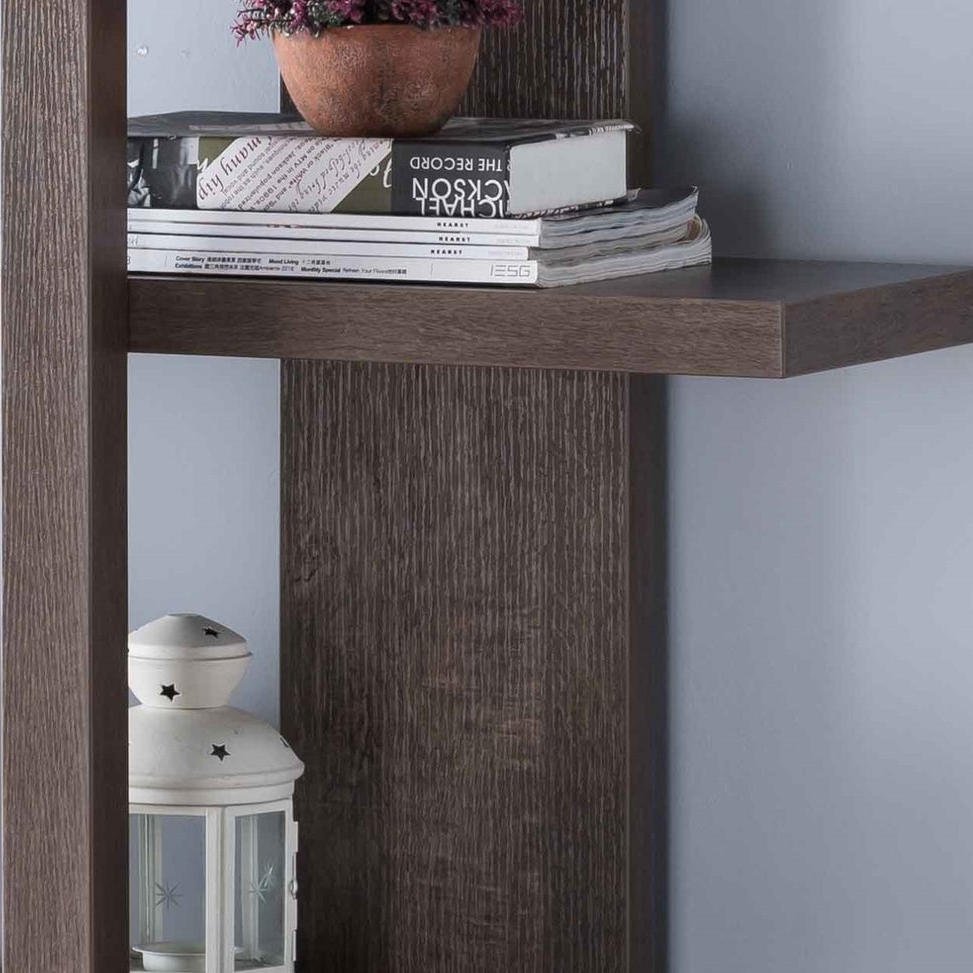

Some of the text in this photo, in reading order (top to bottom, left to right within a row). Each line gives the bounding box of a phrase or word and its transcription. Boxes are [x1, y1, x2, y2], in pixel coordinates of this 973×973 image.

[197, 136, 262, 200] many hip
[271, 150, 296, 174] Jackson
[293, 153, 307, 168] MTV
[410, 157, 473, 171] RECORD
[478, 158, 503, 172] THE
[411, 177, 511, 201] CKSON
[415, 197, 506, 218] ICHAEL
